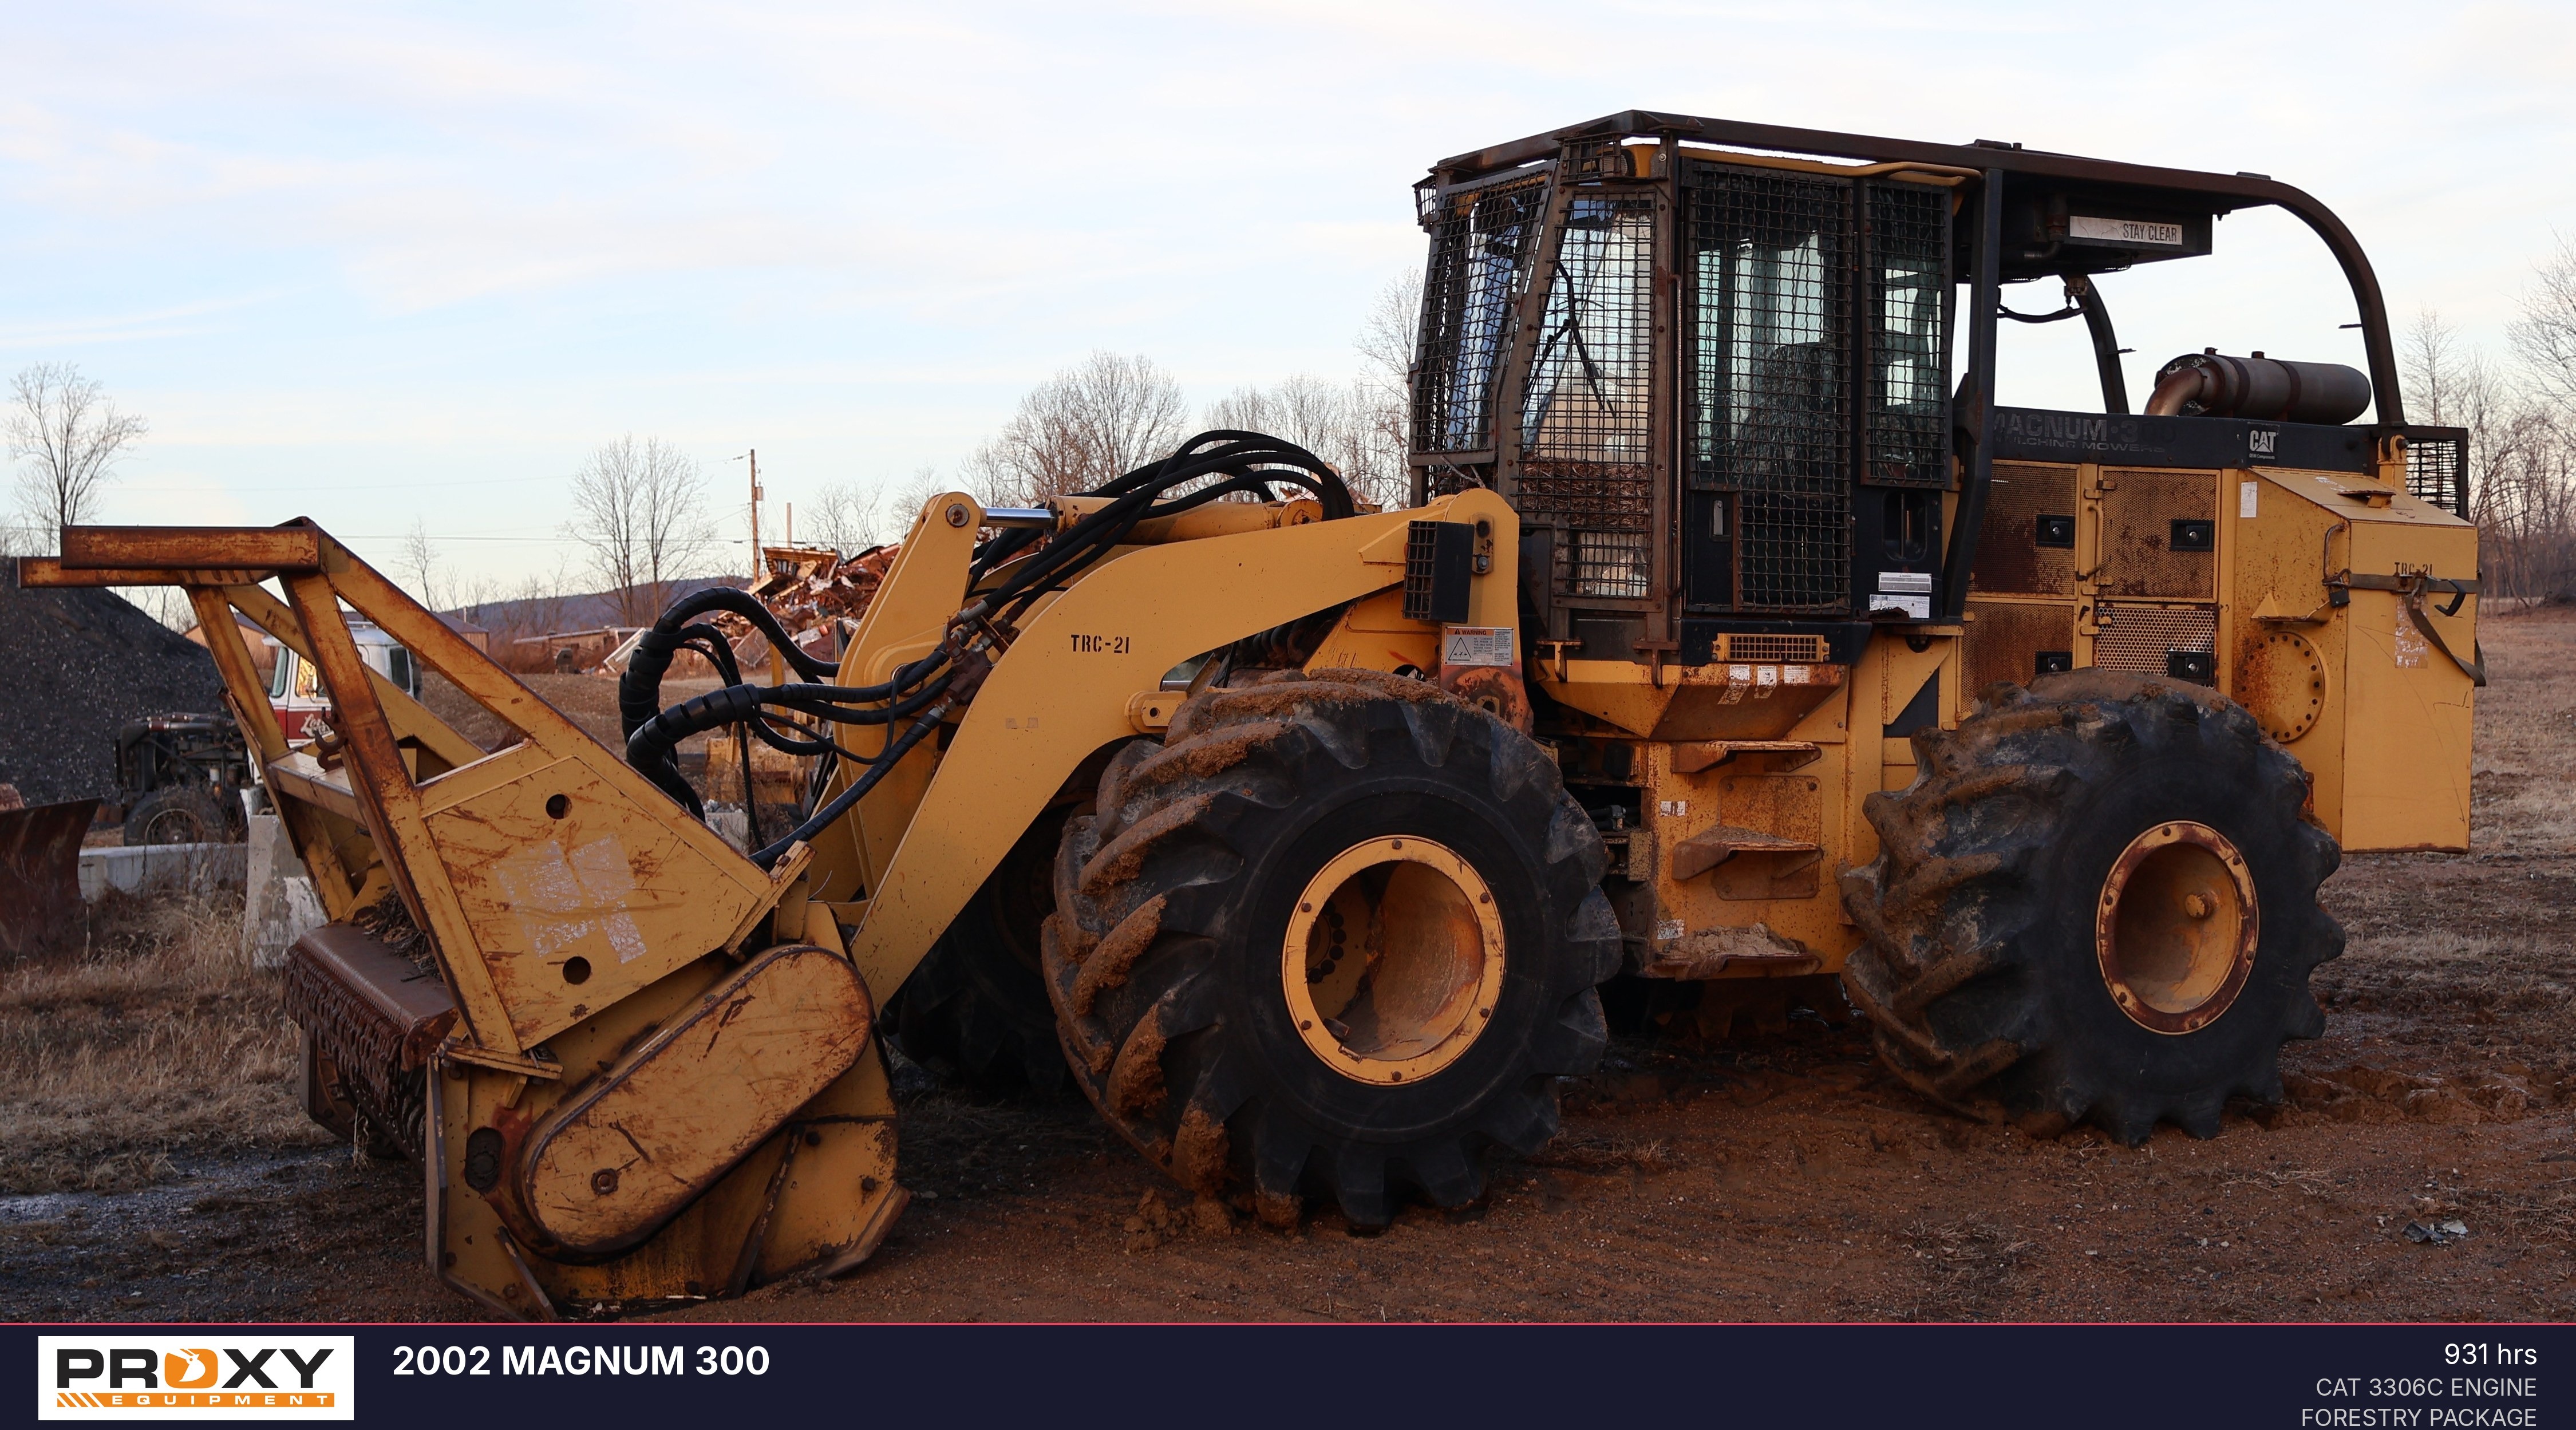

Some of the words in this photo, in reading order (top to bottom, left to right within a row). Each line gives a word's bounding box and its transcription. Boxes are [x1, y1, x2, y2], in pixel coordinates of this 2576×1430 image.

[2123, 223, 2145, 239] STAY
[2148, 226, 2177, 242] CLEAR
[2249, 430, 2276, 453] CAT
[1070, 634, 1129, 654] TRC-21
